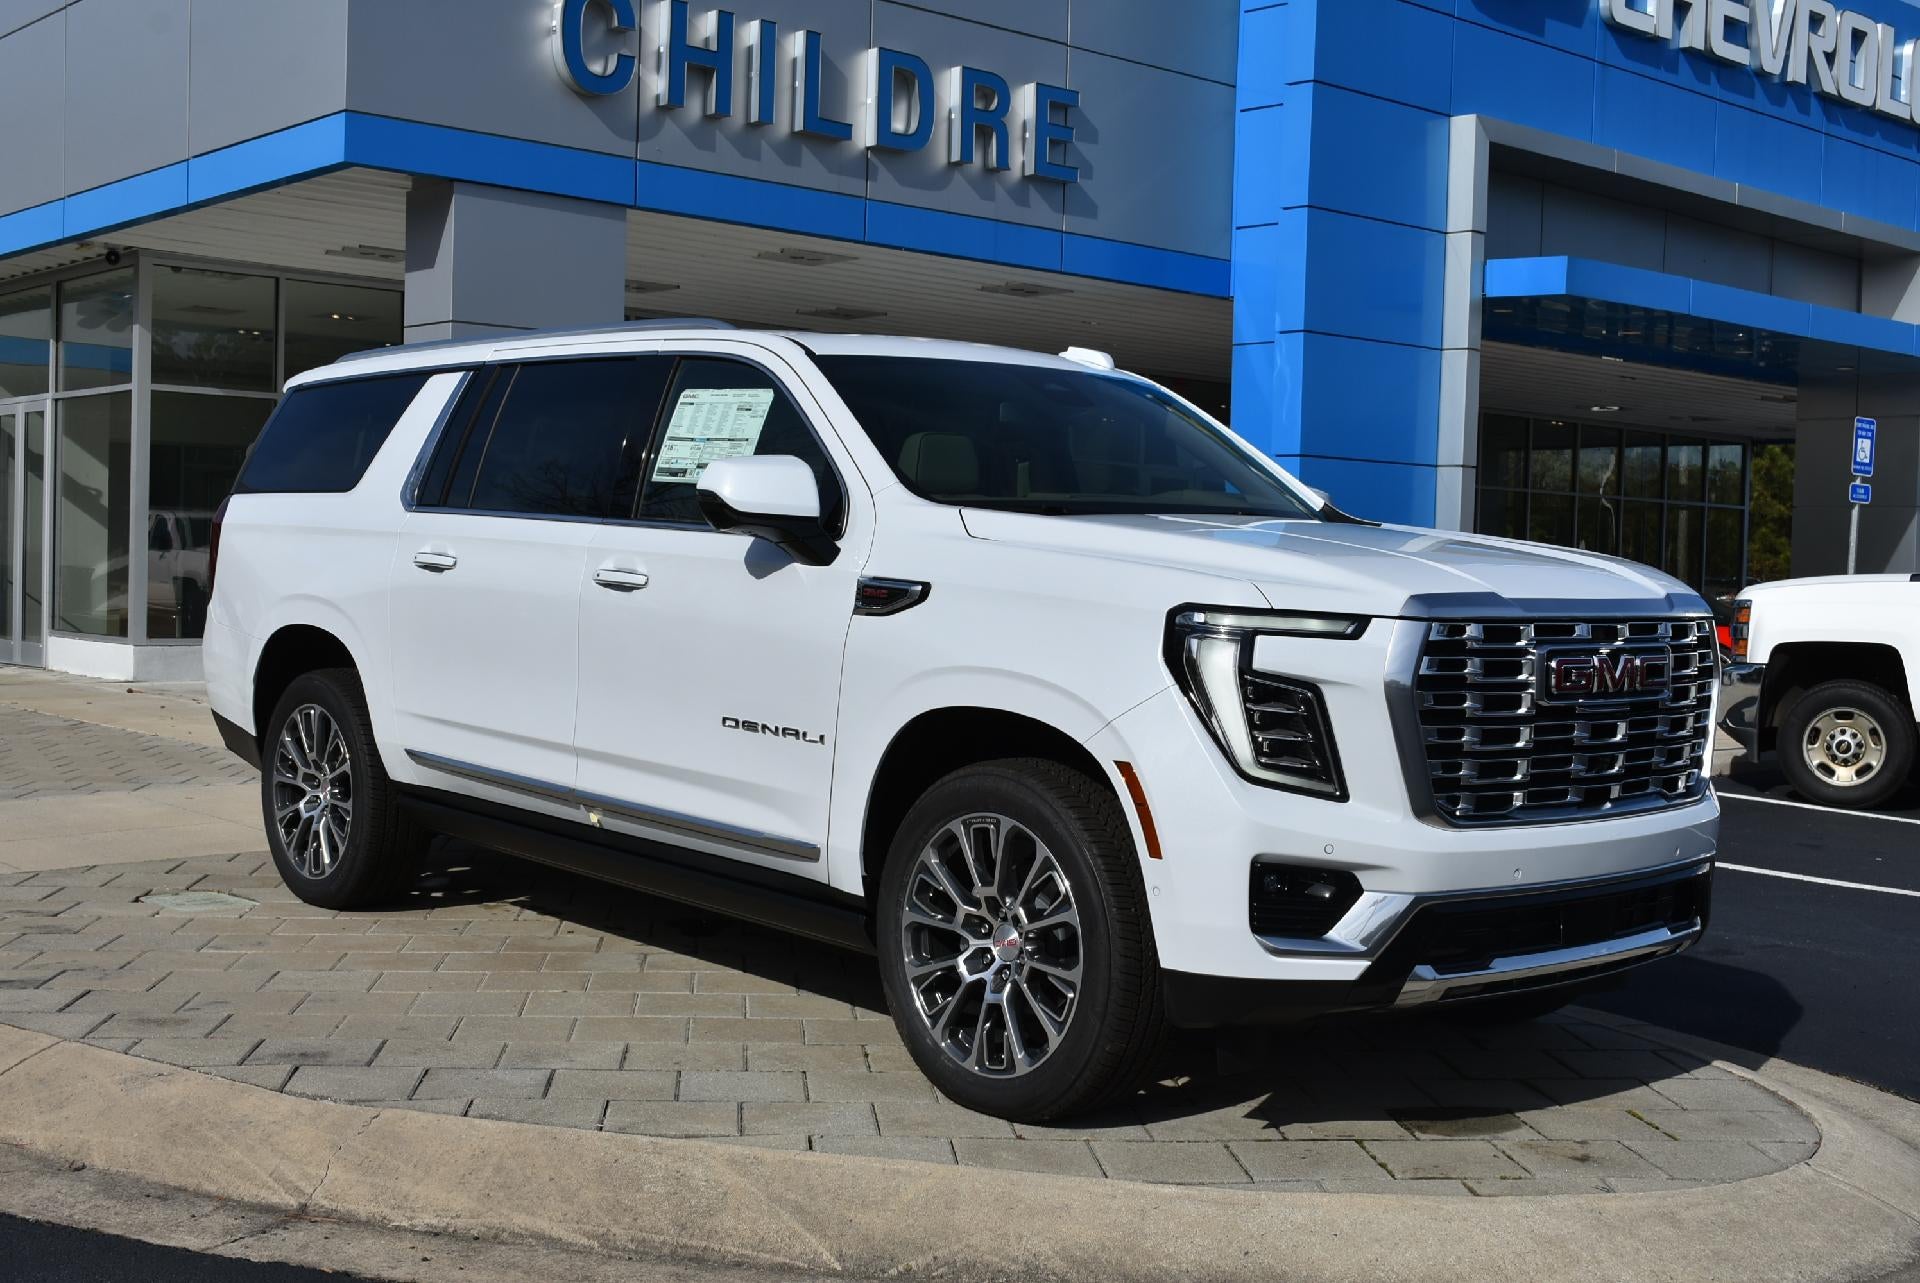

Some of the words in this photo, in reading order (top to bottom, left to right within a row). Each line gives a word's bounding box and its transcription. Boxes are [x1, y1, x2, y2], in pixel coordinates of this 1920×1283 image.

[555, 0, 1080, 182] CHILDRE
[863, 587, 888, 598] GMC
[1552, 655, 1669, 695] GMC
[721, 716, 826, 746] DENALI
